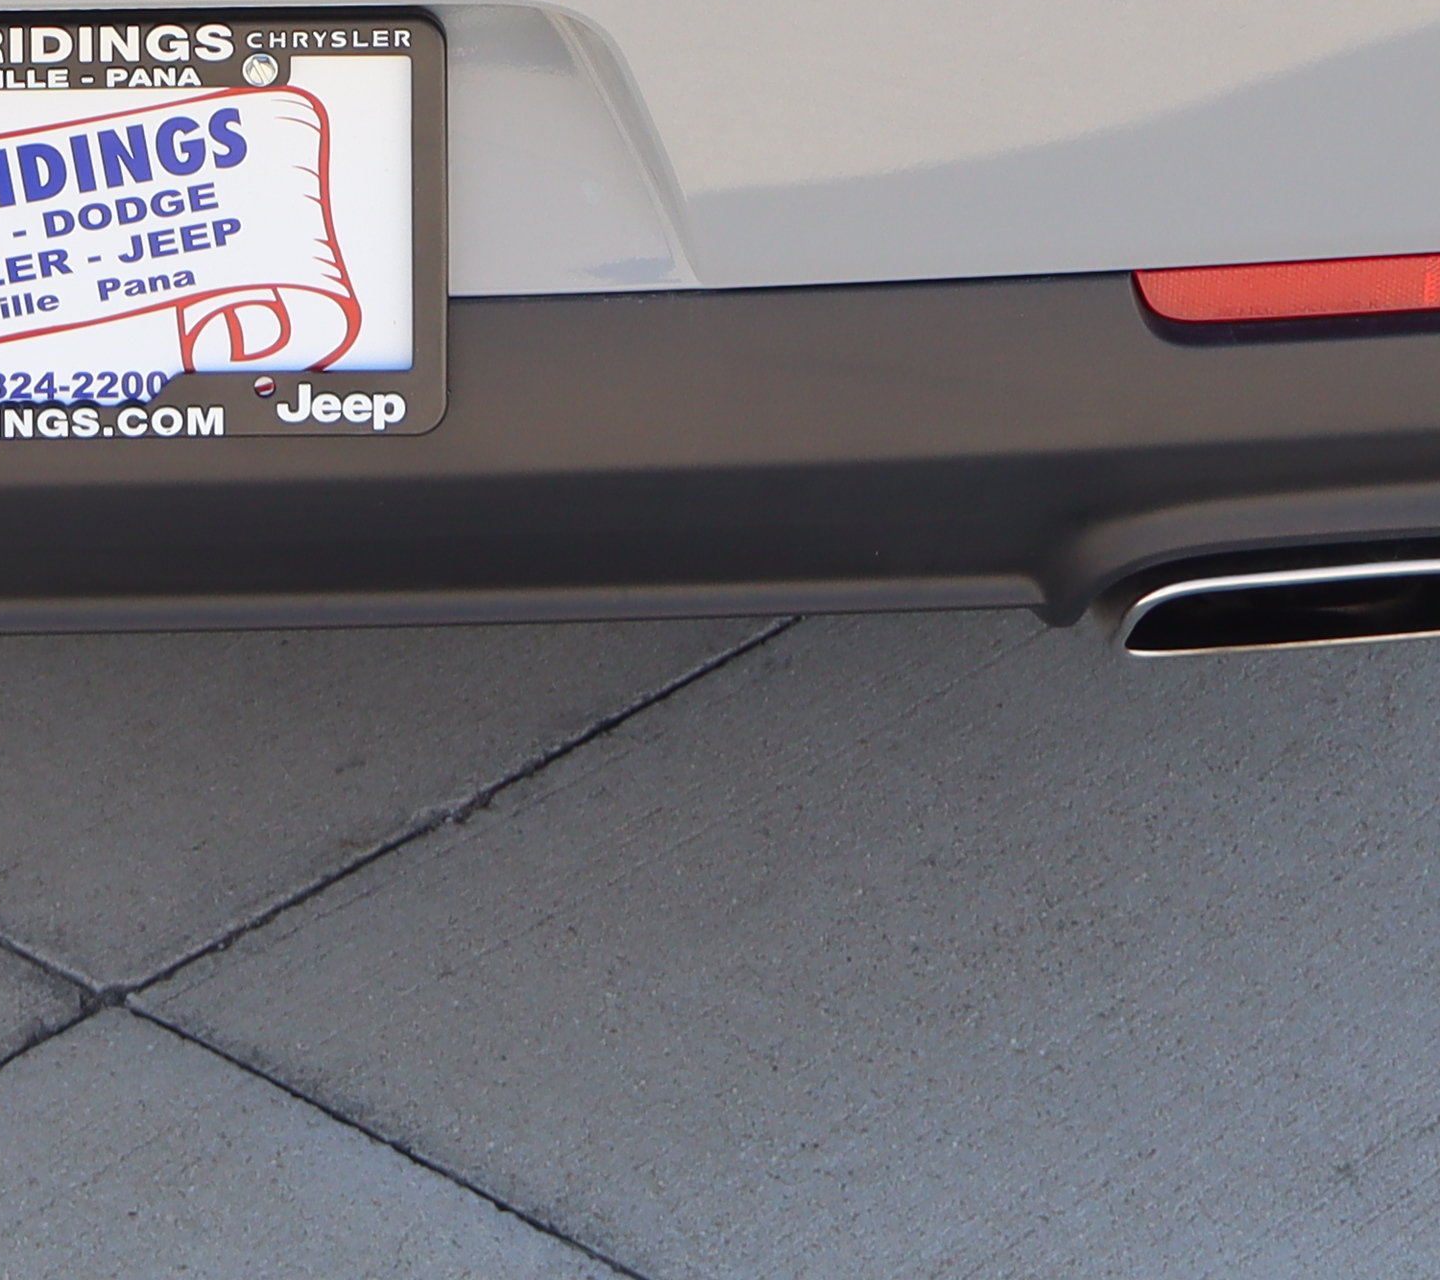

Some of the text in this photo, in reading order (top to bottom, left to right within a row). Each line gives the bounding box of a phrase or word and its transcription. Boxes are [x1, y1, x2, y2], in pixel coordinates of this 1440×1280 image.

[246, 30, 411, 48] CHRYSLER
[106, 67, 202, 88] PANA
[42, 182, 219, 238] DODGE
[118, 218, 242, 263] JEEP
[97, 269, 197, 301] Pana
[276, 383, 406, 431] Jeep
